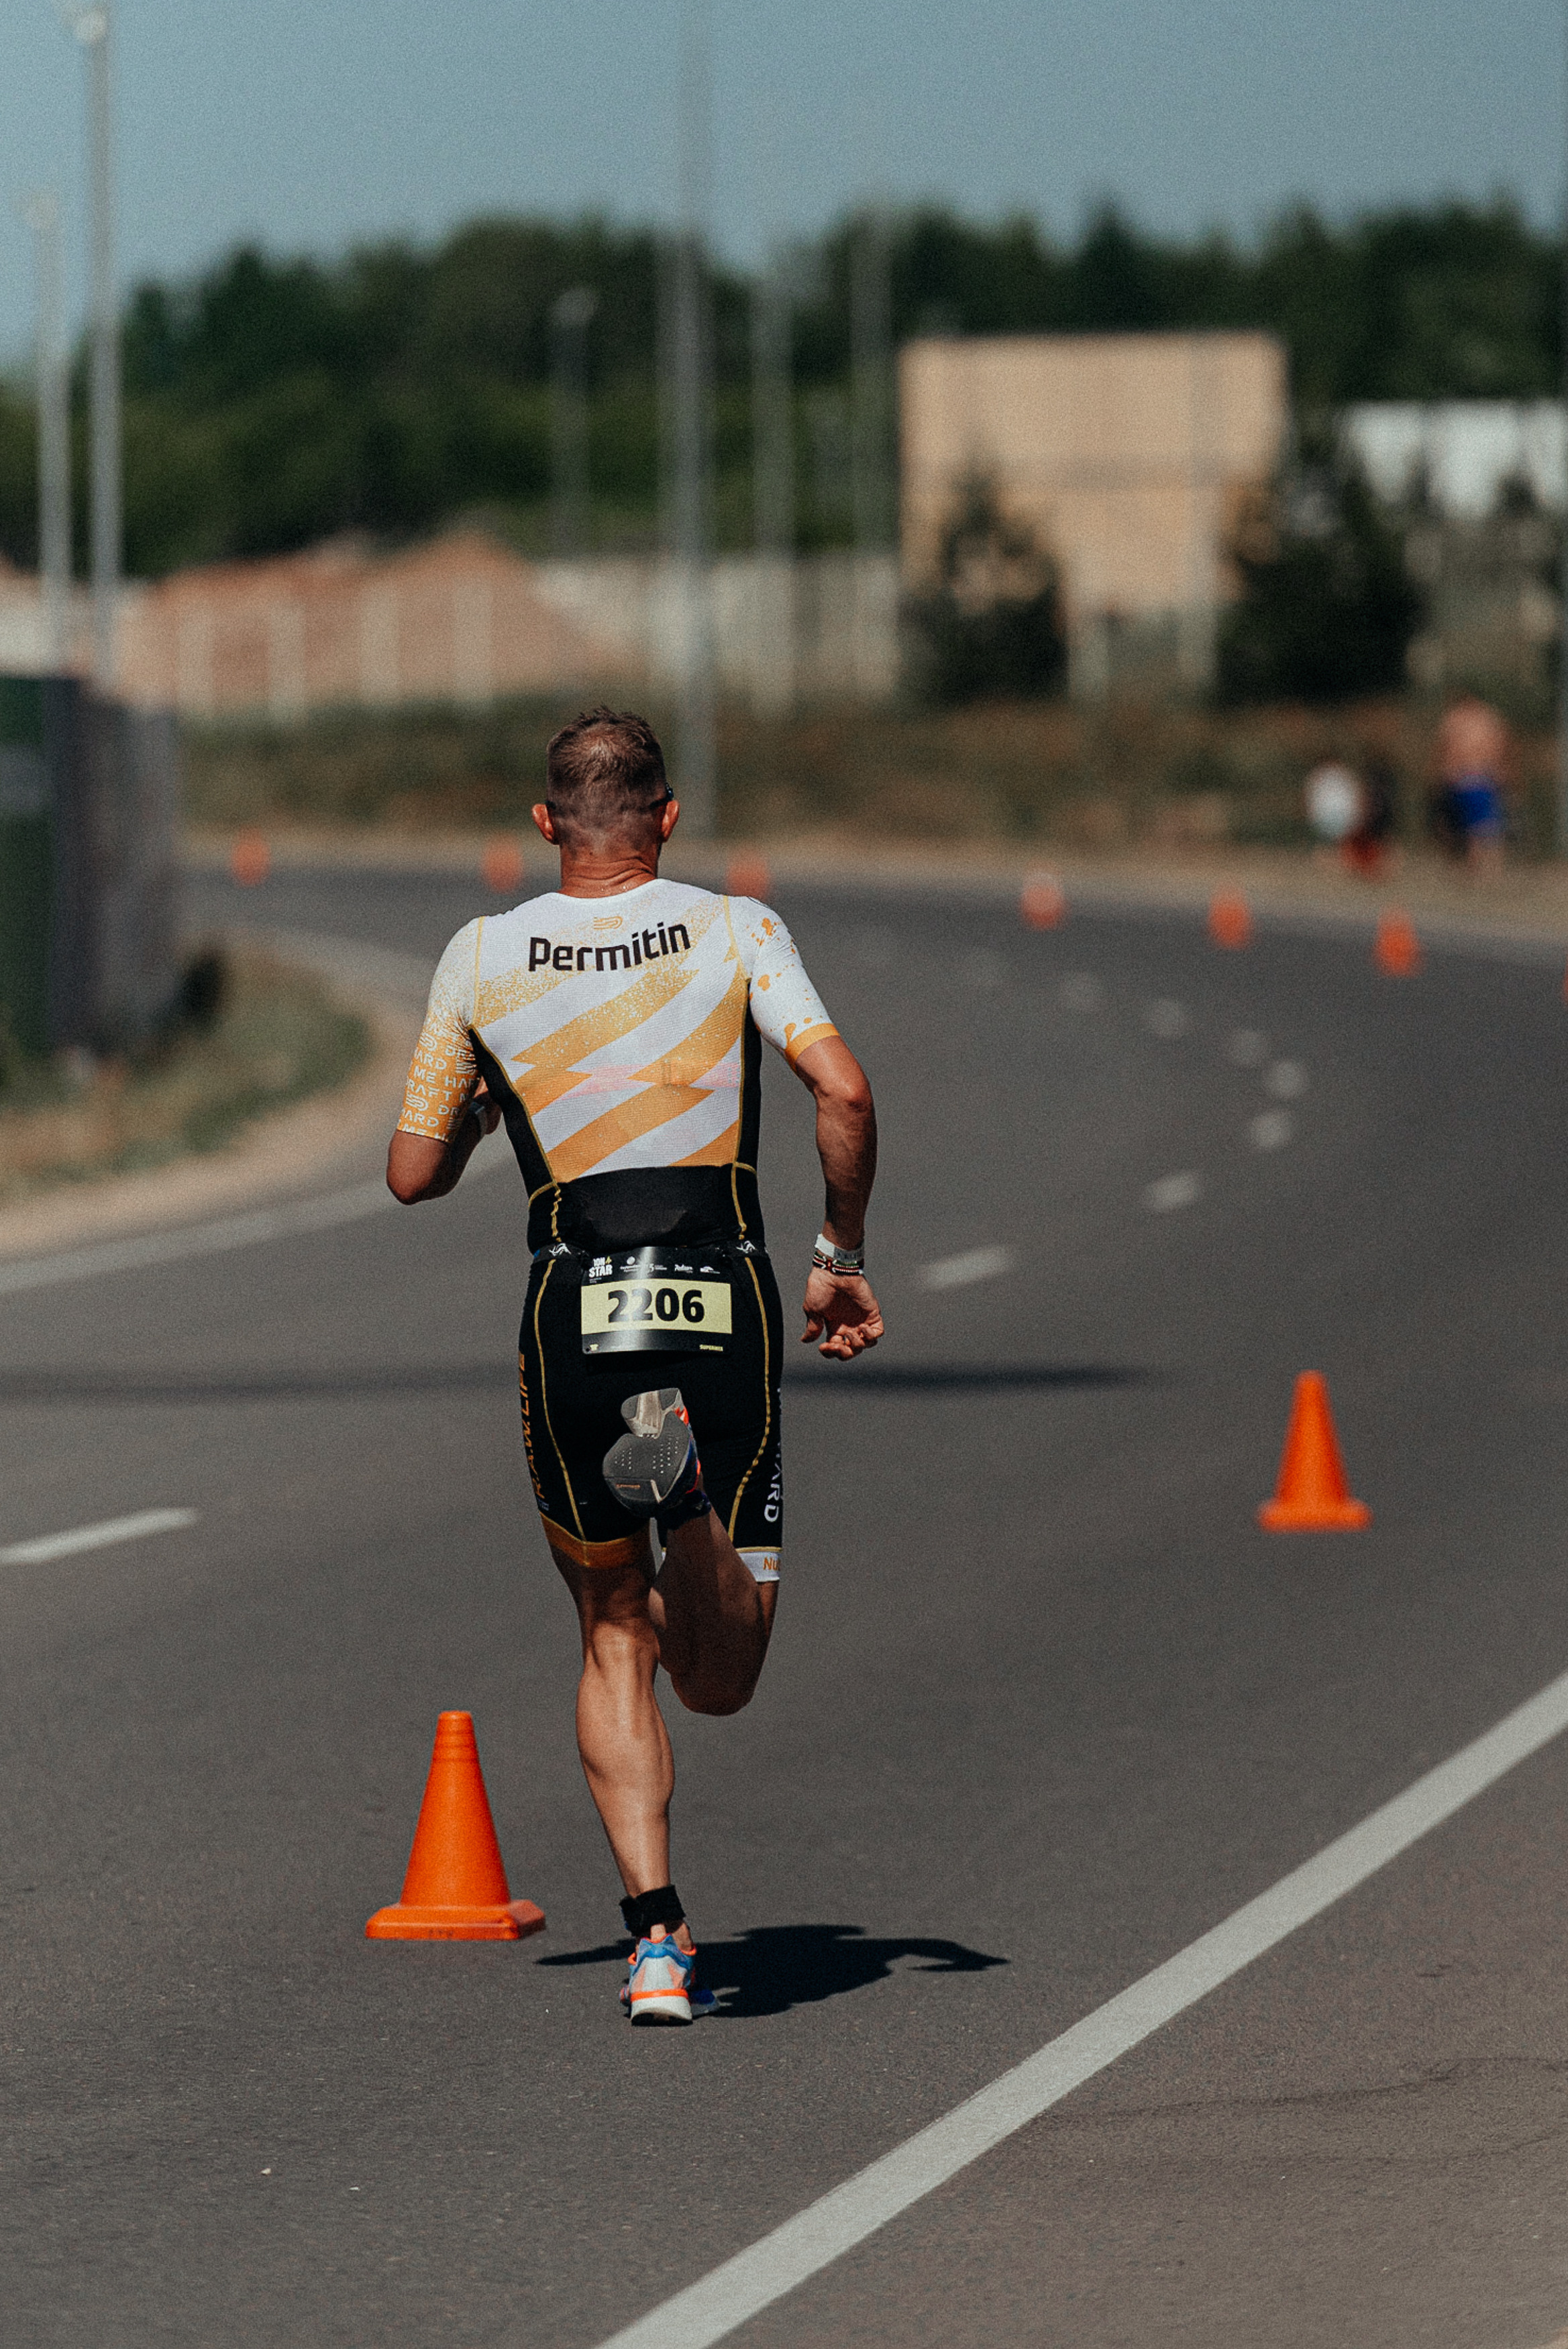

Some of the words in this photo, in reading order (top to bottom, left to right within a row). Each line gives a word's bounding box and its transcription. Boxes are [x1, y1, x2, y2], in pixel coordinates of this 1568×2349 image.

[528, 921, 691, 972] Permitin
[588, 1264, 613, 1278] STAR
[608, 1287, 705, 1323] 2206
